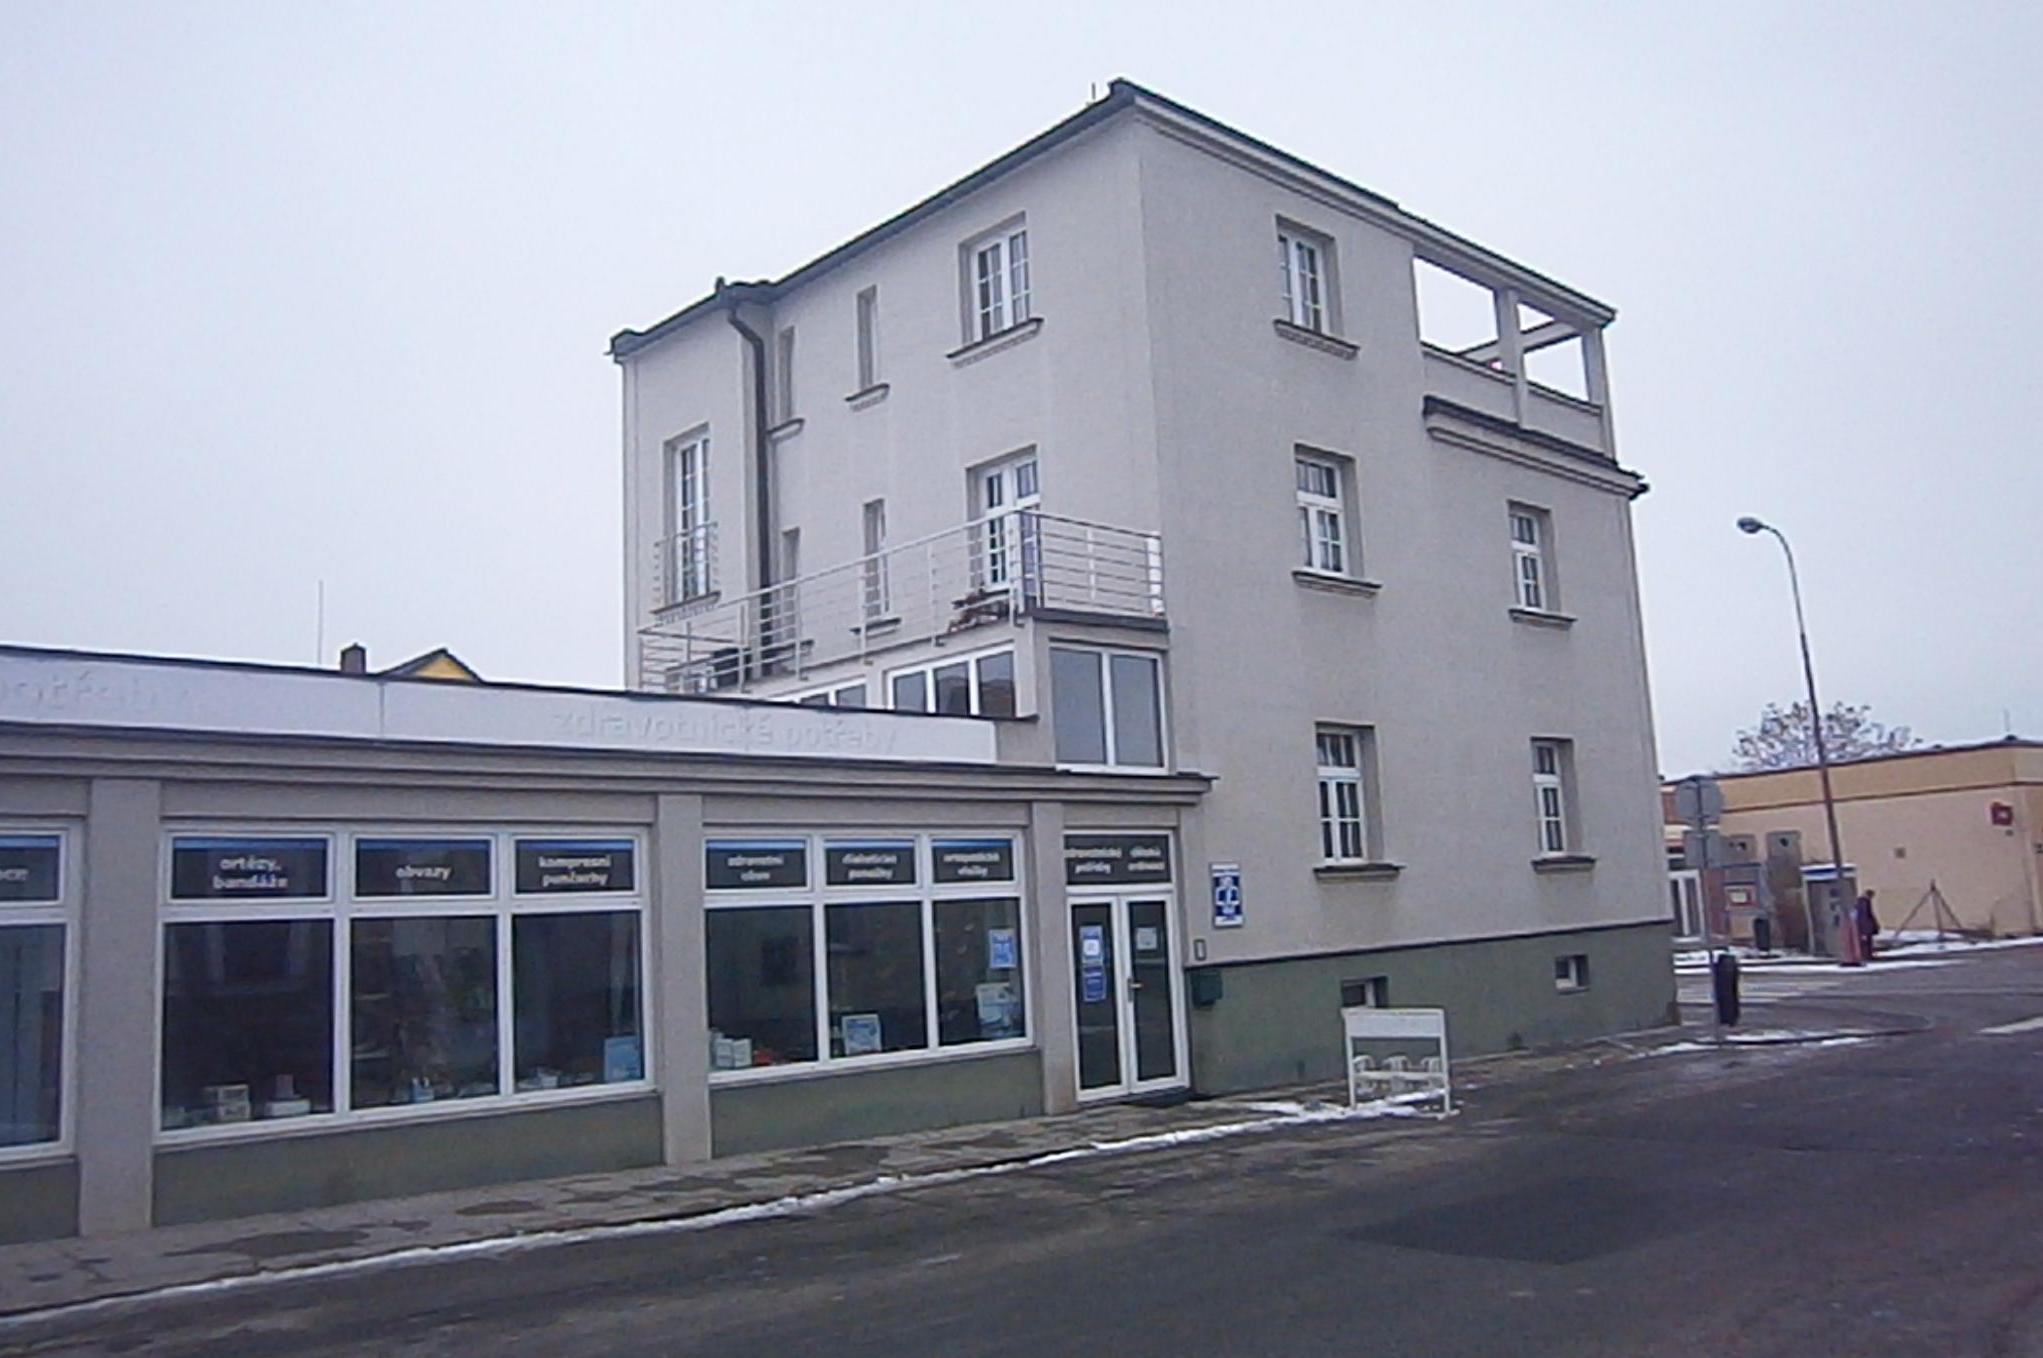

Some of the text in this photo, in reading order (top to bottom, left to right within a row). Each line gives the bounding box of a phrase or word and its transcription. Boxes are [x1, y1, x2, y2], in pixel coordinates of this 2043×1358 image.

[552, 706, 898, 753] zdravotnické potřeby
[396, 865, 450, 880] obvazy
